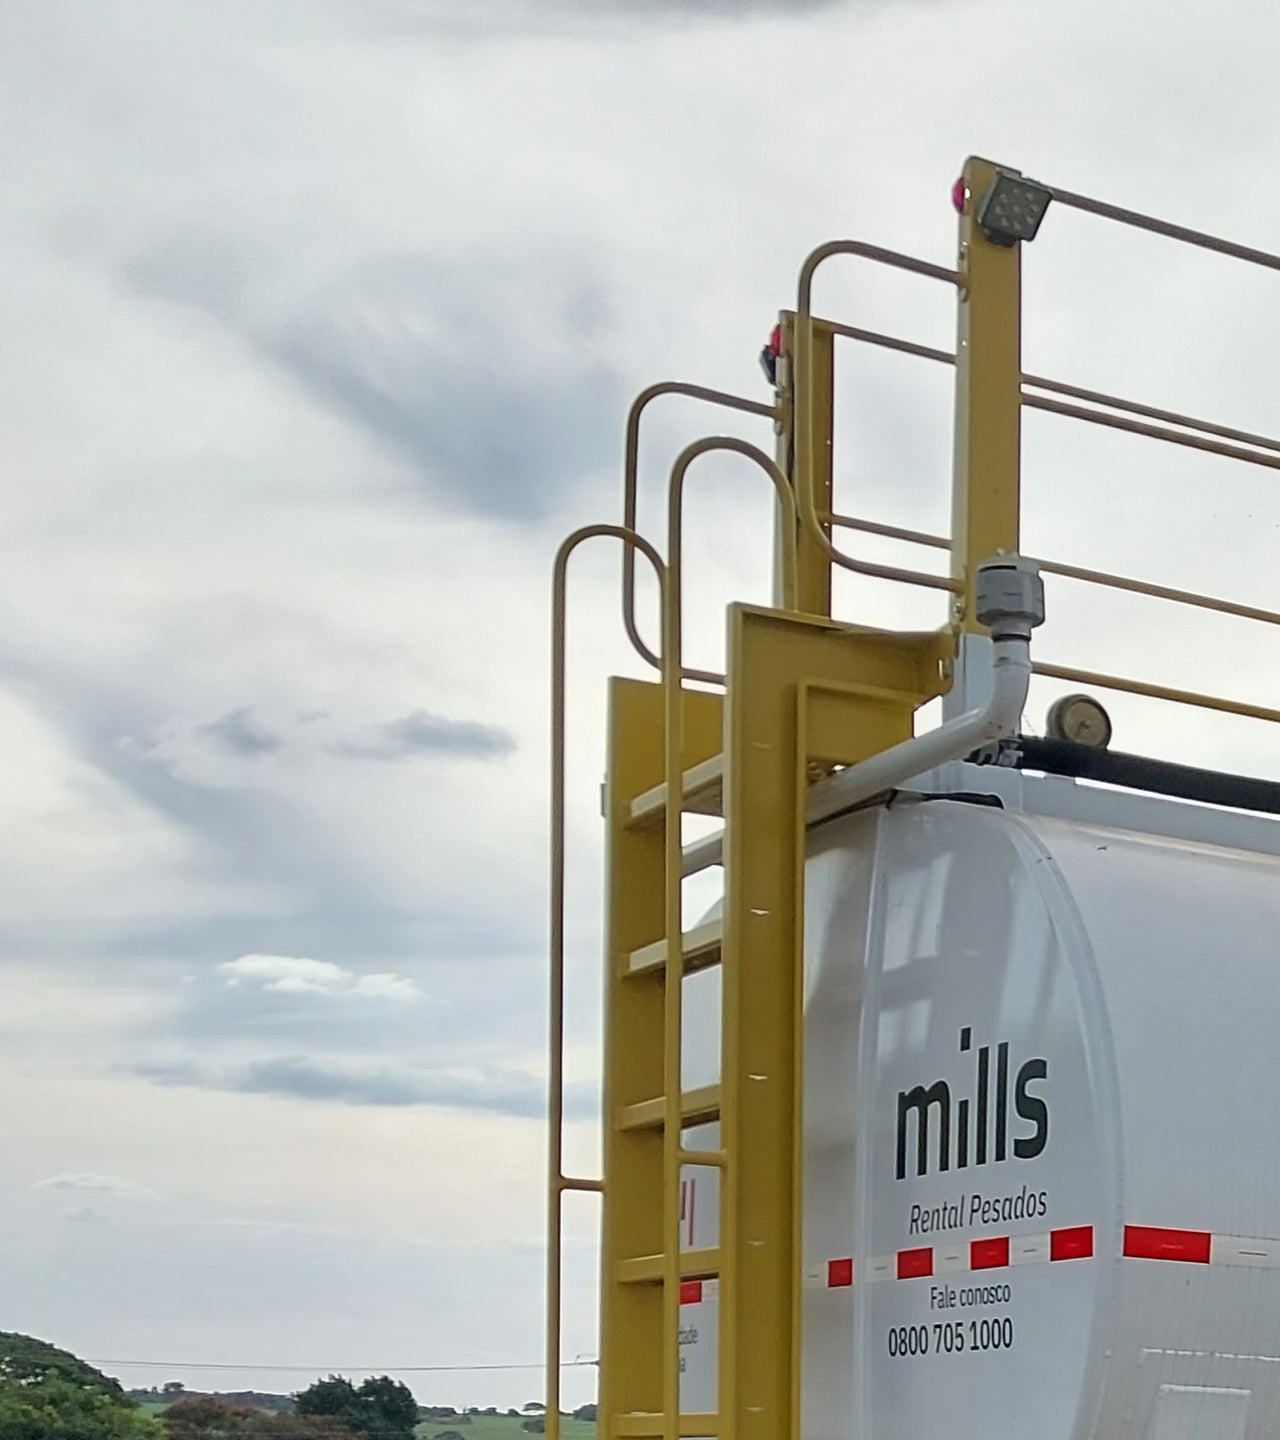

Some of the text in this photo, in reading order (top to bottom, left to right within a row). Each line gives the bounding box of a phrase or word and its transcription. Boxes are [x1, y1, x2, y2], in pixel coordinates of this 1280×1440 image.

[895, 1026, 1049, 1180] mills
[909, 1184, 1048, 1236] Rental Pesados
[929, 1283, 1011, 1310] Fale conosco
[888, 1317, 1013, 1357] 0800 705 1000
